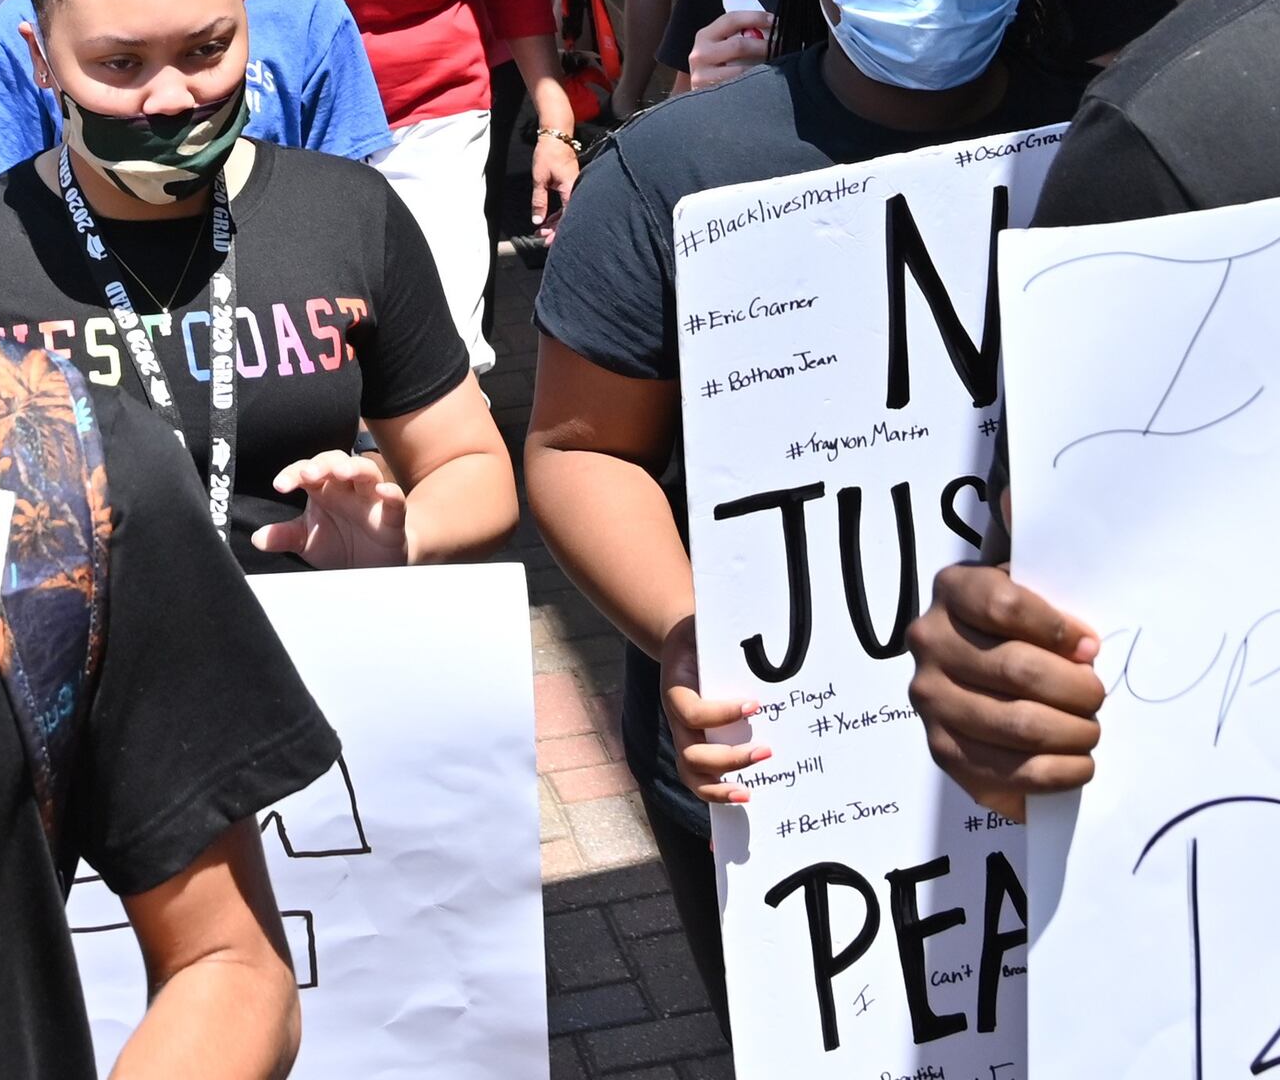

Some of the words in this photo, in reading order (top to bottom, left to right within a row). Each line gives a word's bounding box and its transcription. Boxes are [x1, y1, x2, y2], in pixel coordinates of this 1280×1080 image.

[65, 187, 95, 234] 2020
[213, 206, 230, 253] GRAD
[105, 281, 139, 330] GRAD
[212, 305, 234, 352] 2020
[126, 328, 161, 376] 2020
[212, 355, 234, 410] GRAD
[209, 474, 231, 526] 2020
